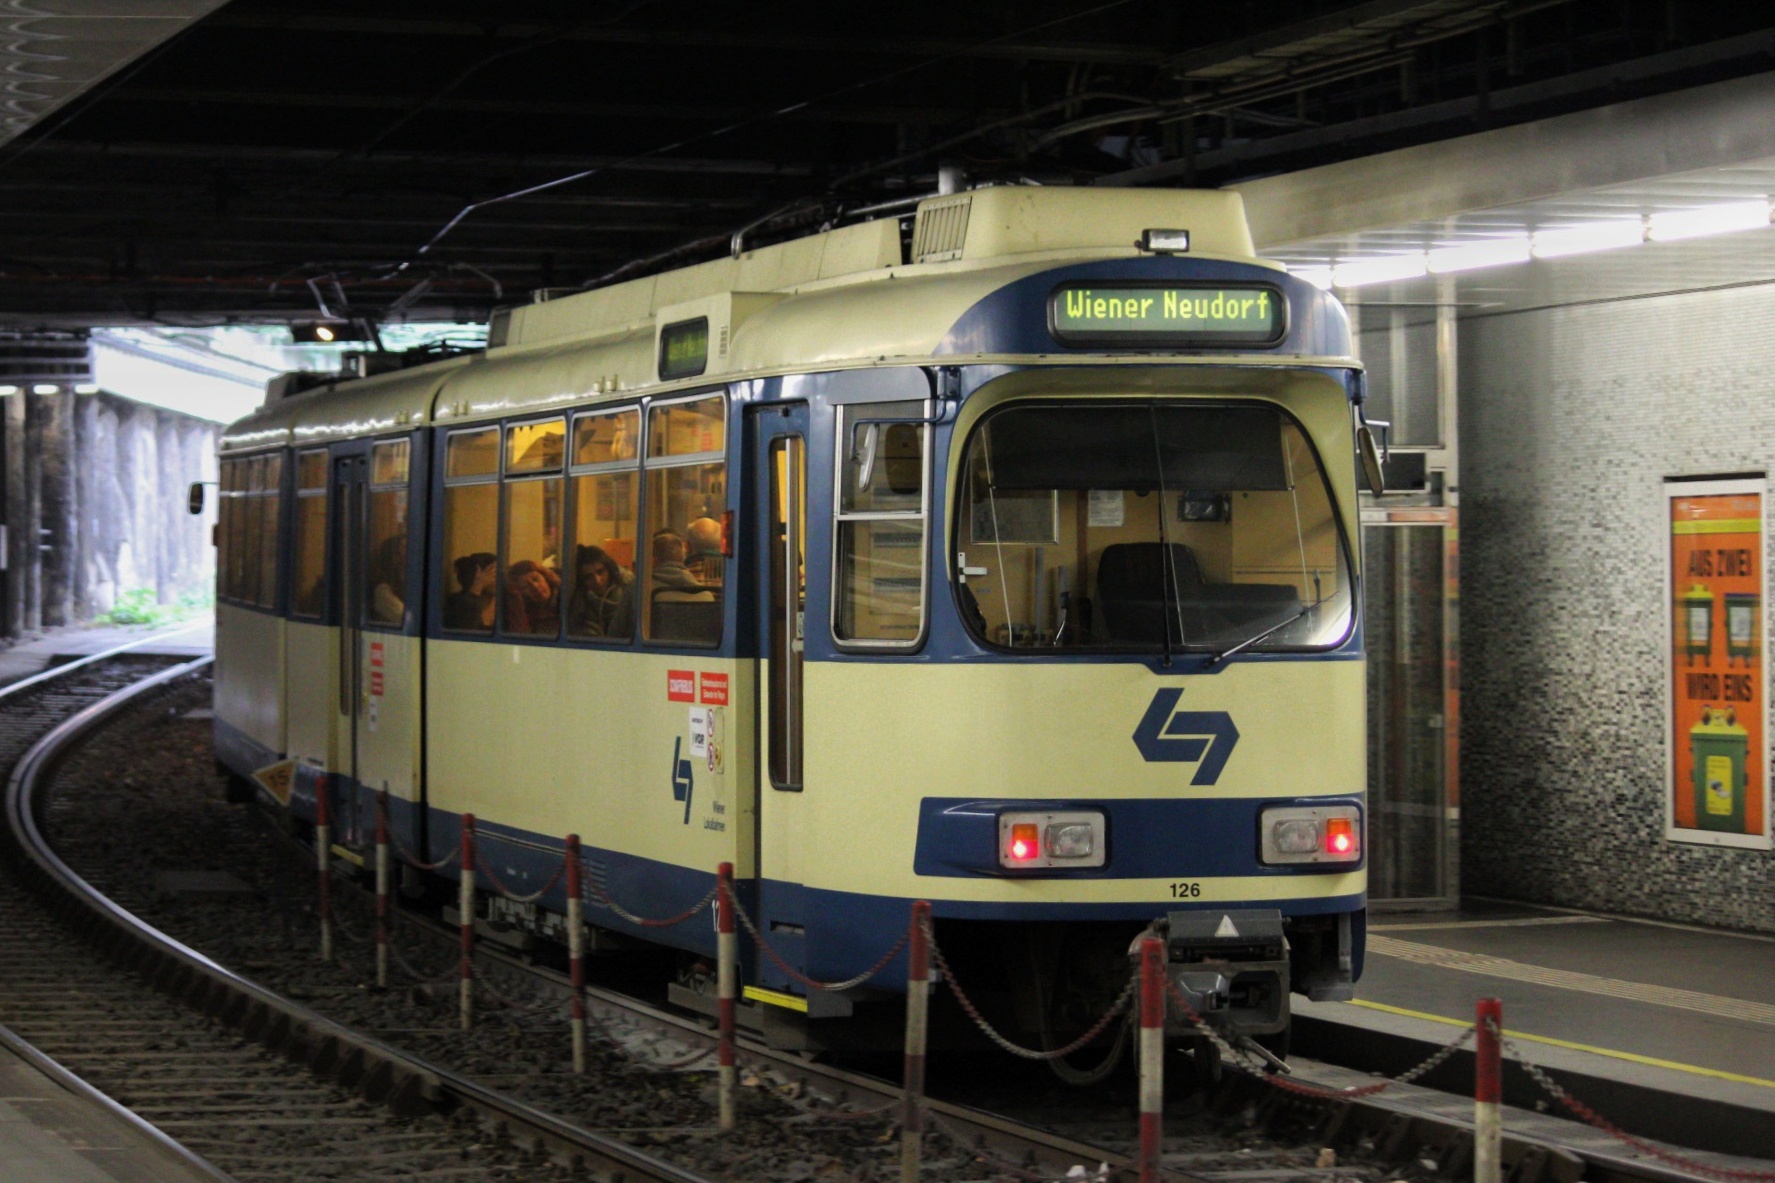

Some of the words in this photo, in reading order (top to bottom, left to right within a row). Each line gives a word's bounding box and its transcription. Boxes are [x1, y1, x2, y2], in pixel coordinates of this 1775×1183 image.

[1066, 290, 1153, 318] Wiener
[1163, 291, 1268, 319] Neudorf
[1169, 882, 1201, 898] 126
